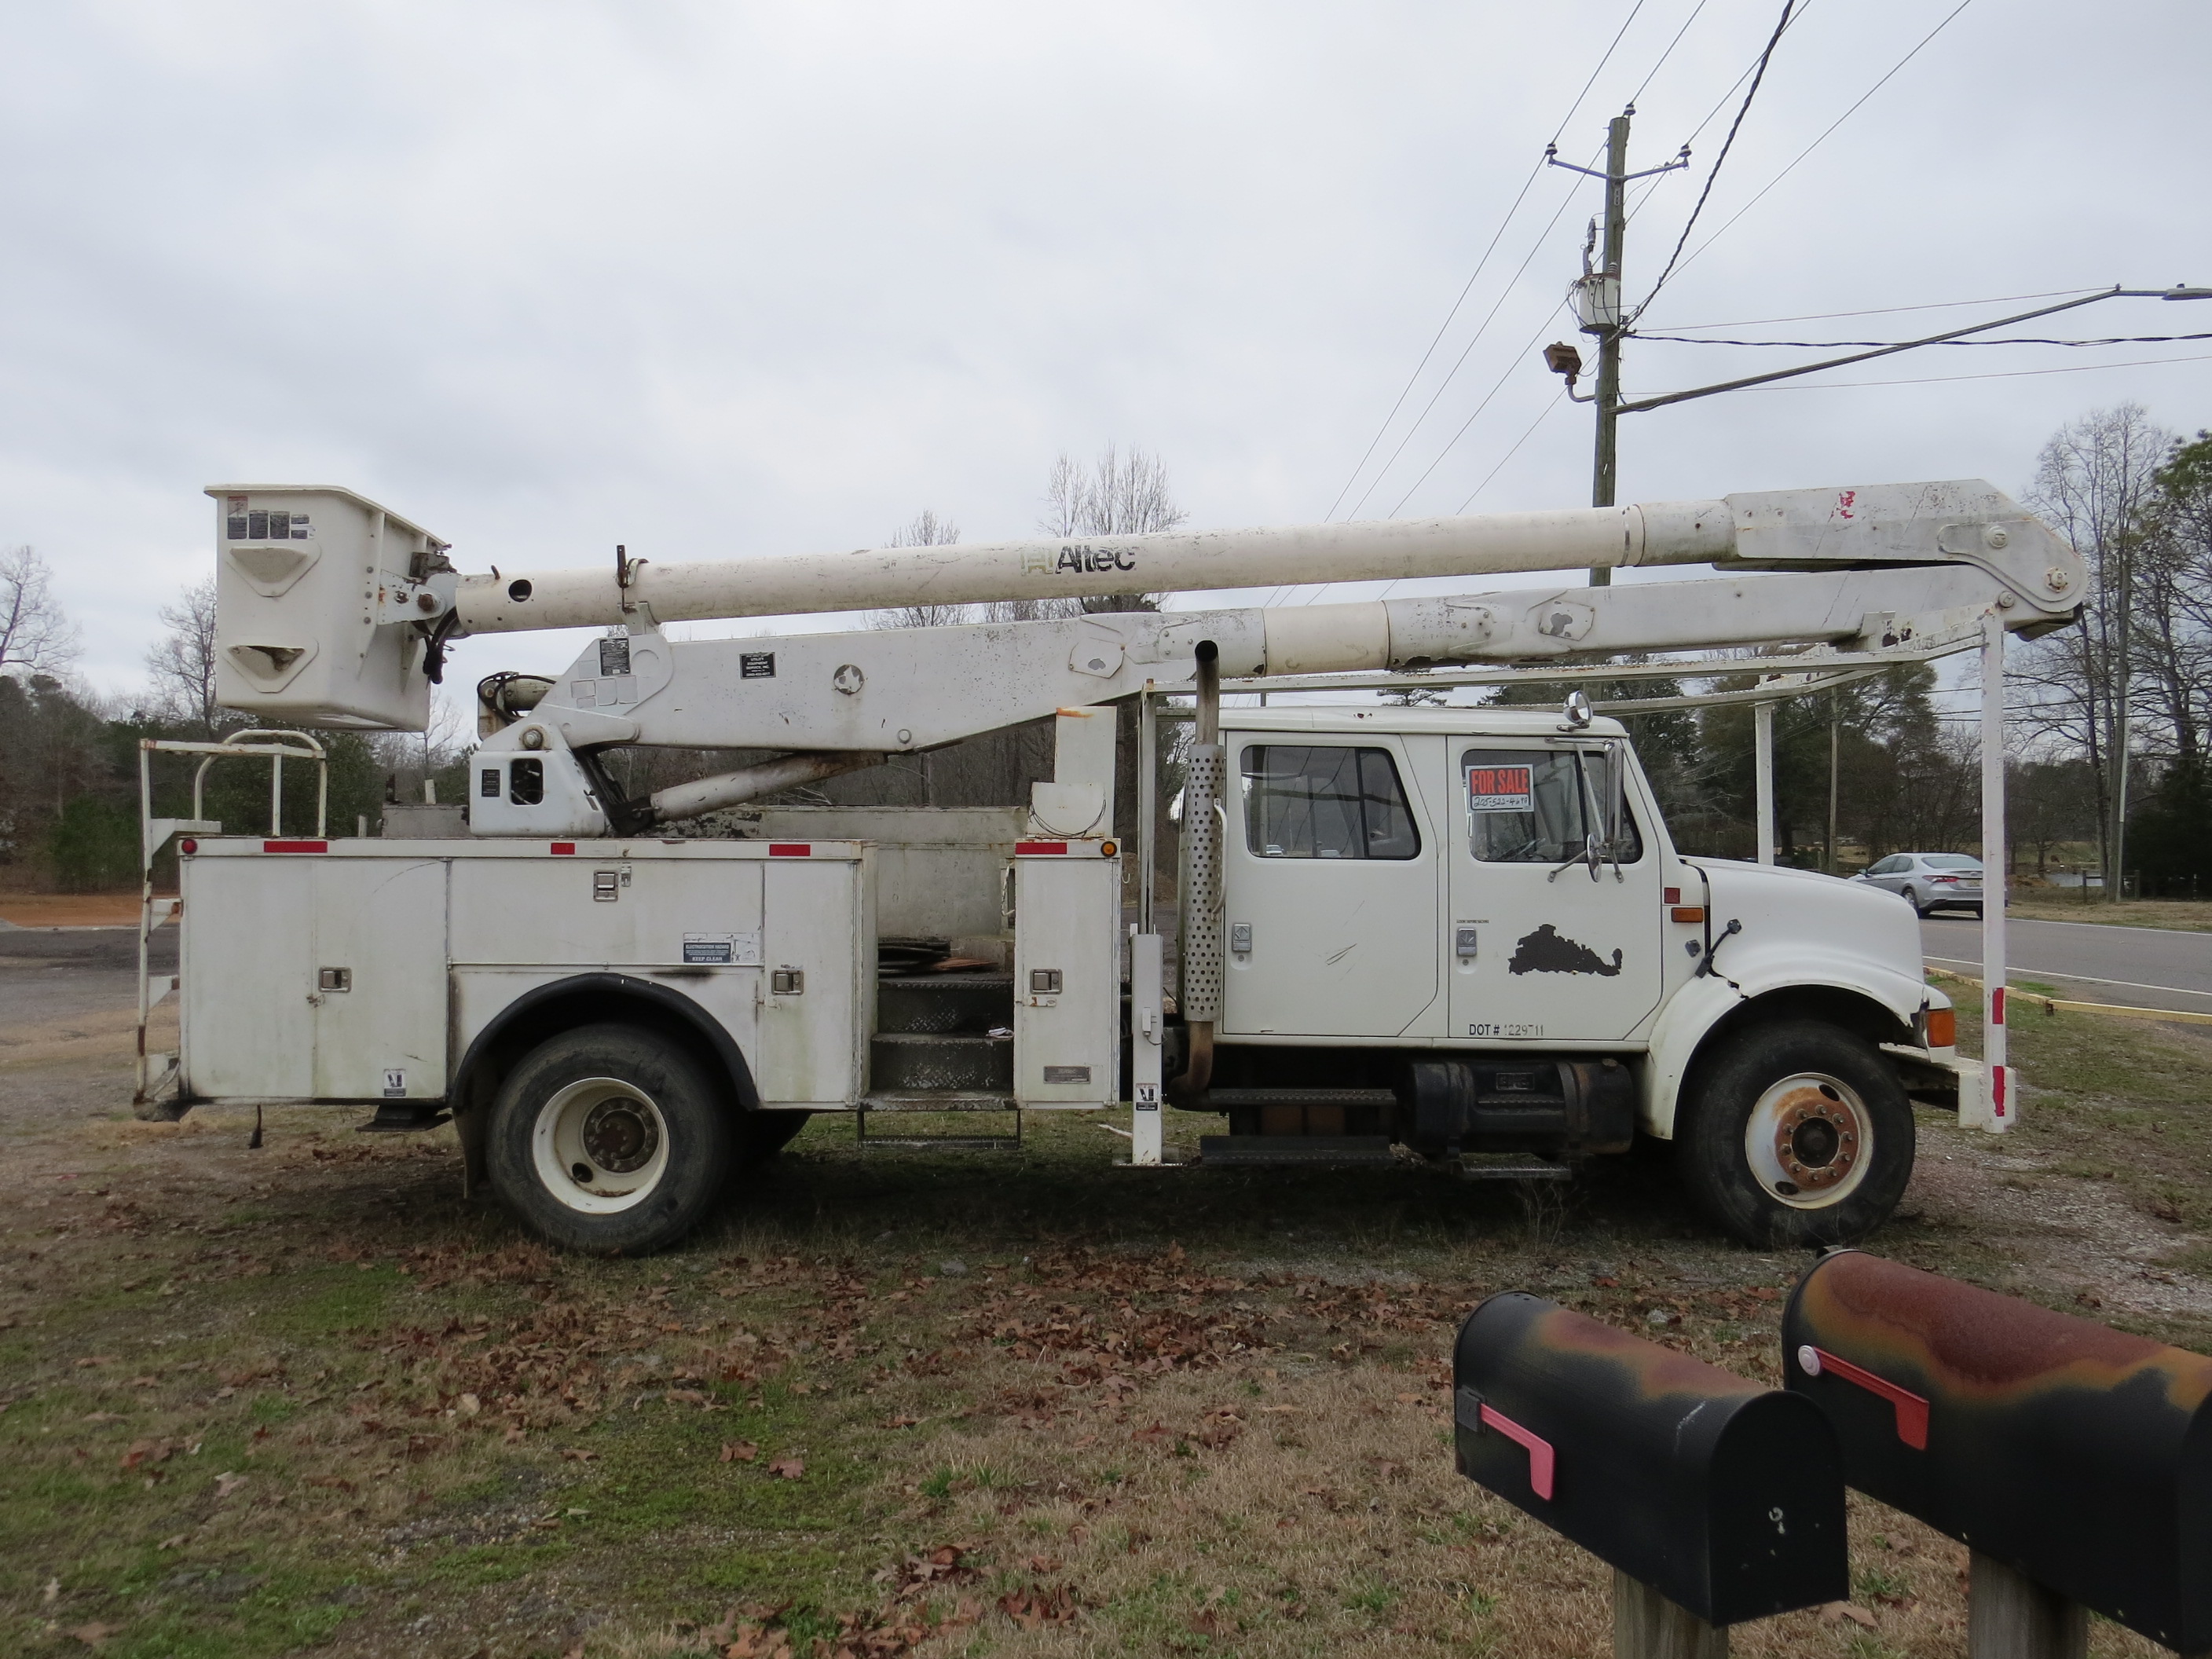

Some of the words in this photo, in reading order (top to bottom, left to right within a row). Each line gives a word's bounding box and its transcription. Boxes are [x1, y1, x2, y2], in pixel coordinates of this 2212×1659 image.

[1055, 545, 1136, 574] Altec
[1472, 771, 1495, 794] FOR
[1498, 769, 1529, 793] SALE
[1469, 1024, 1491, 1036] DOT
[1493, 1024, 1500, 1036] #
